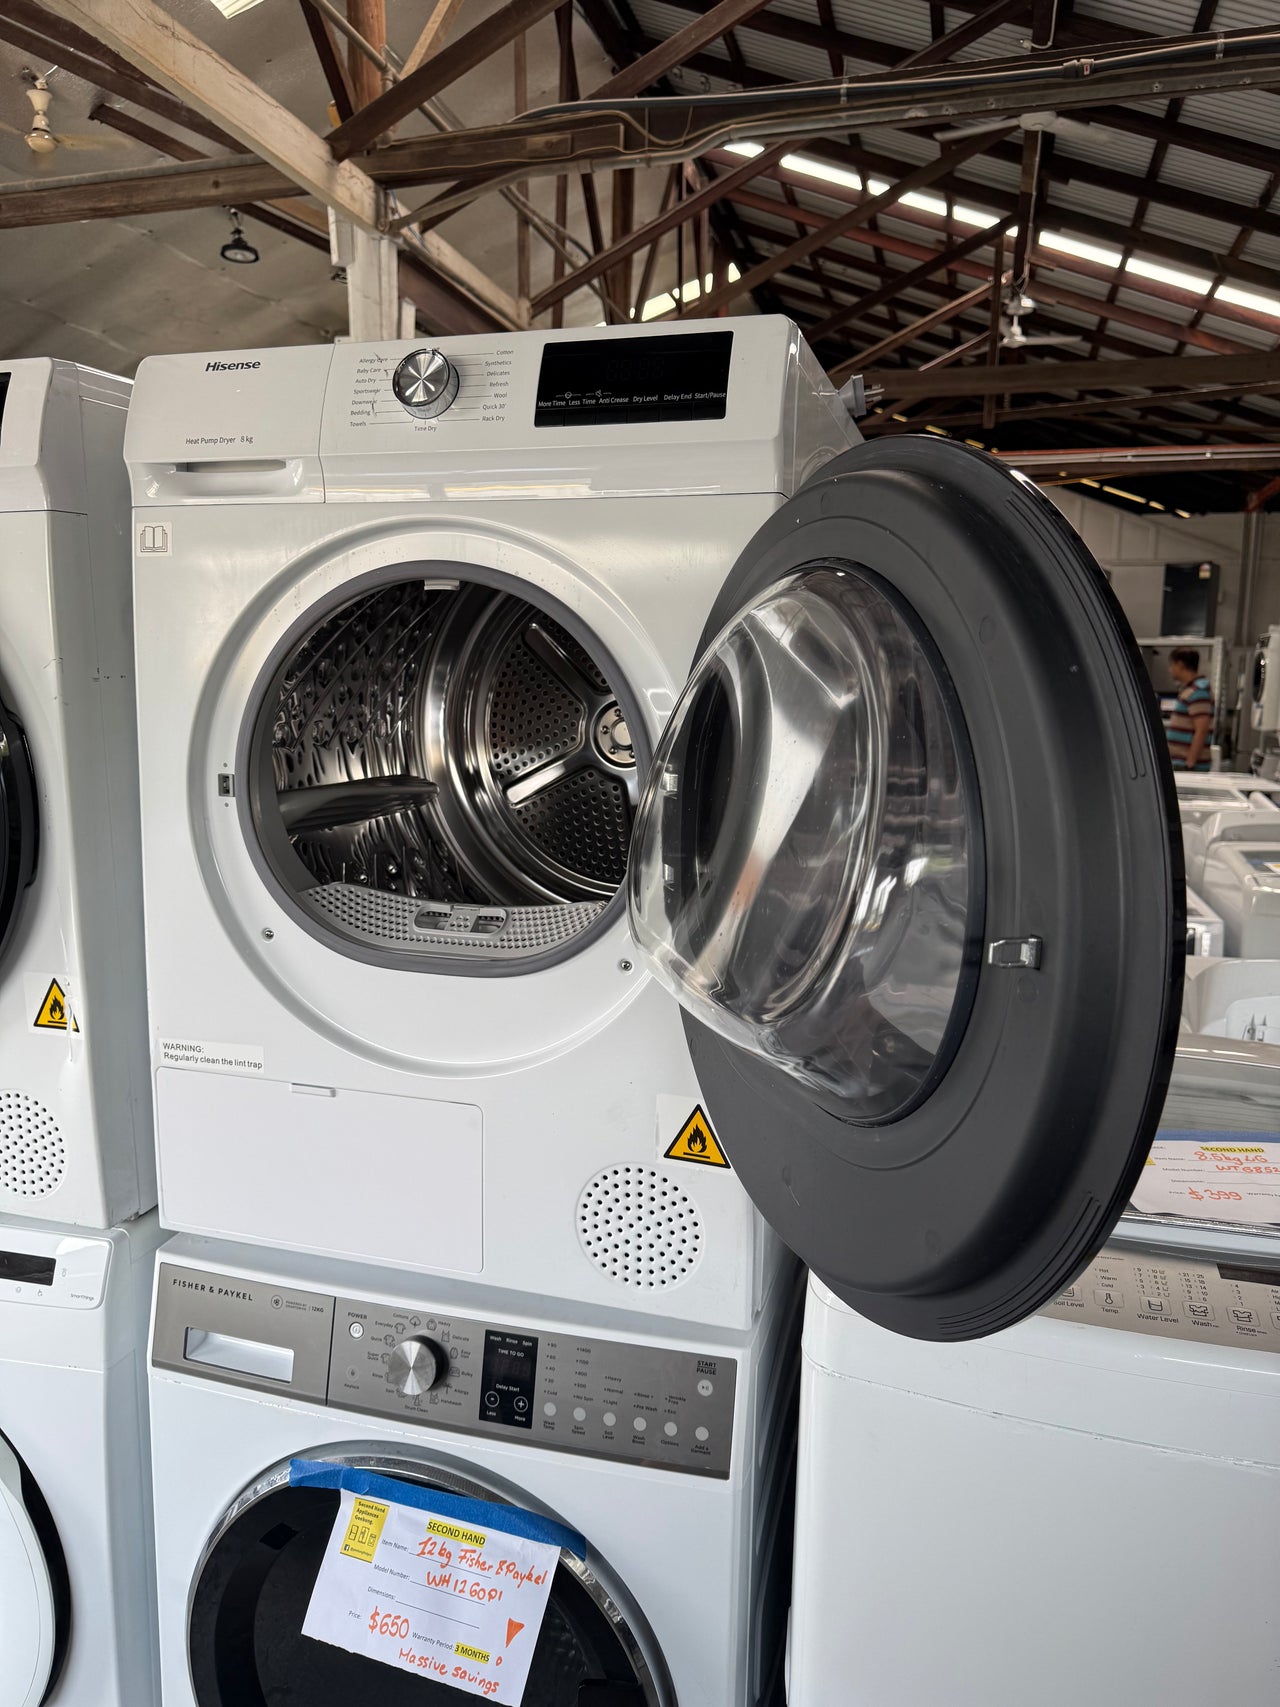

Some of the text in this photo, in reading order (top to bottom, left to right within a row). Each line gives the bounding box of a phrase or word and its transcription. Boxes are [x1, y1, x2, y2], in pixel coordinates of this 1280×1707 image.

[206, 360, 261, 372] Hisense
[186, 437, 200, 445] Heat
[201, 437, 218, 445] Pump
[219, 436, 236, 444] Dryer
[246, 436, 254, 444] kg
[163, 1042, 204, 1053] WARNING:
[164, 1052, 199, 1063] Regularly
[200, 1056, 220, 1064] clean
[235, 1059, 246, 1067] lint
[247, 1061, 263, 1069] trap
[1245, 1155, 1268, 1163] LG
[173, 1279, 205, 1291] FISHER
[218, 1288, 253, 1301] PAYKEL
[1137, 1313, 1159, 1321] Water
[375, 1321, 393, 1329] Everyday
[1237, 1325, 1256, 1333] Rinse
[697, 1360, 716, 1368] START
[697, 1367, 716, 1375] PAUSE
[357, 1508, 379, 1518] Appliances
[358, 1502, 385, 1513] Second Hand
[427, 1521, 486, 1546] SECOND HAND
[382, 1538, 393, 1548] Item
[394, 1542, 408, 1552] Name:
[458, 1548, 493, 1572] Fisher
[374, 1564, 389, 1574] Model
[390, 1568, 410, 1581] Number:
[368, 1586, 395, 1600] Dimensions:
[348, 1610, 362, 1619] Price:
[368, 1605, 410, 1639] $650
[412, 1632, 435, 1646] Warranty
[436, 1639, 454, 1651] Period:
[460, 1646, 490, 1662] MONTHS
[398, 1647, 447, 1676] Massive
[452, 1666, 500, 1695] savings
